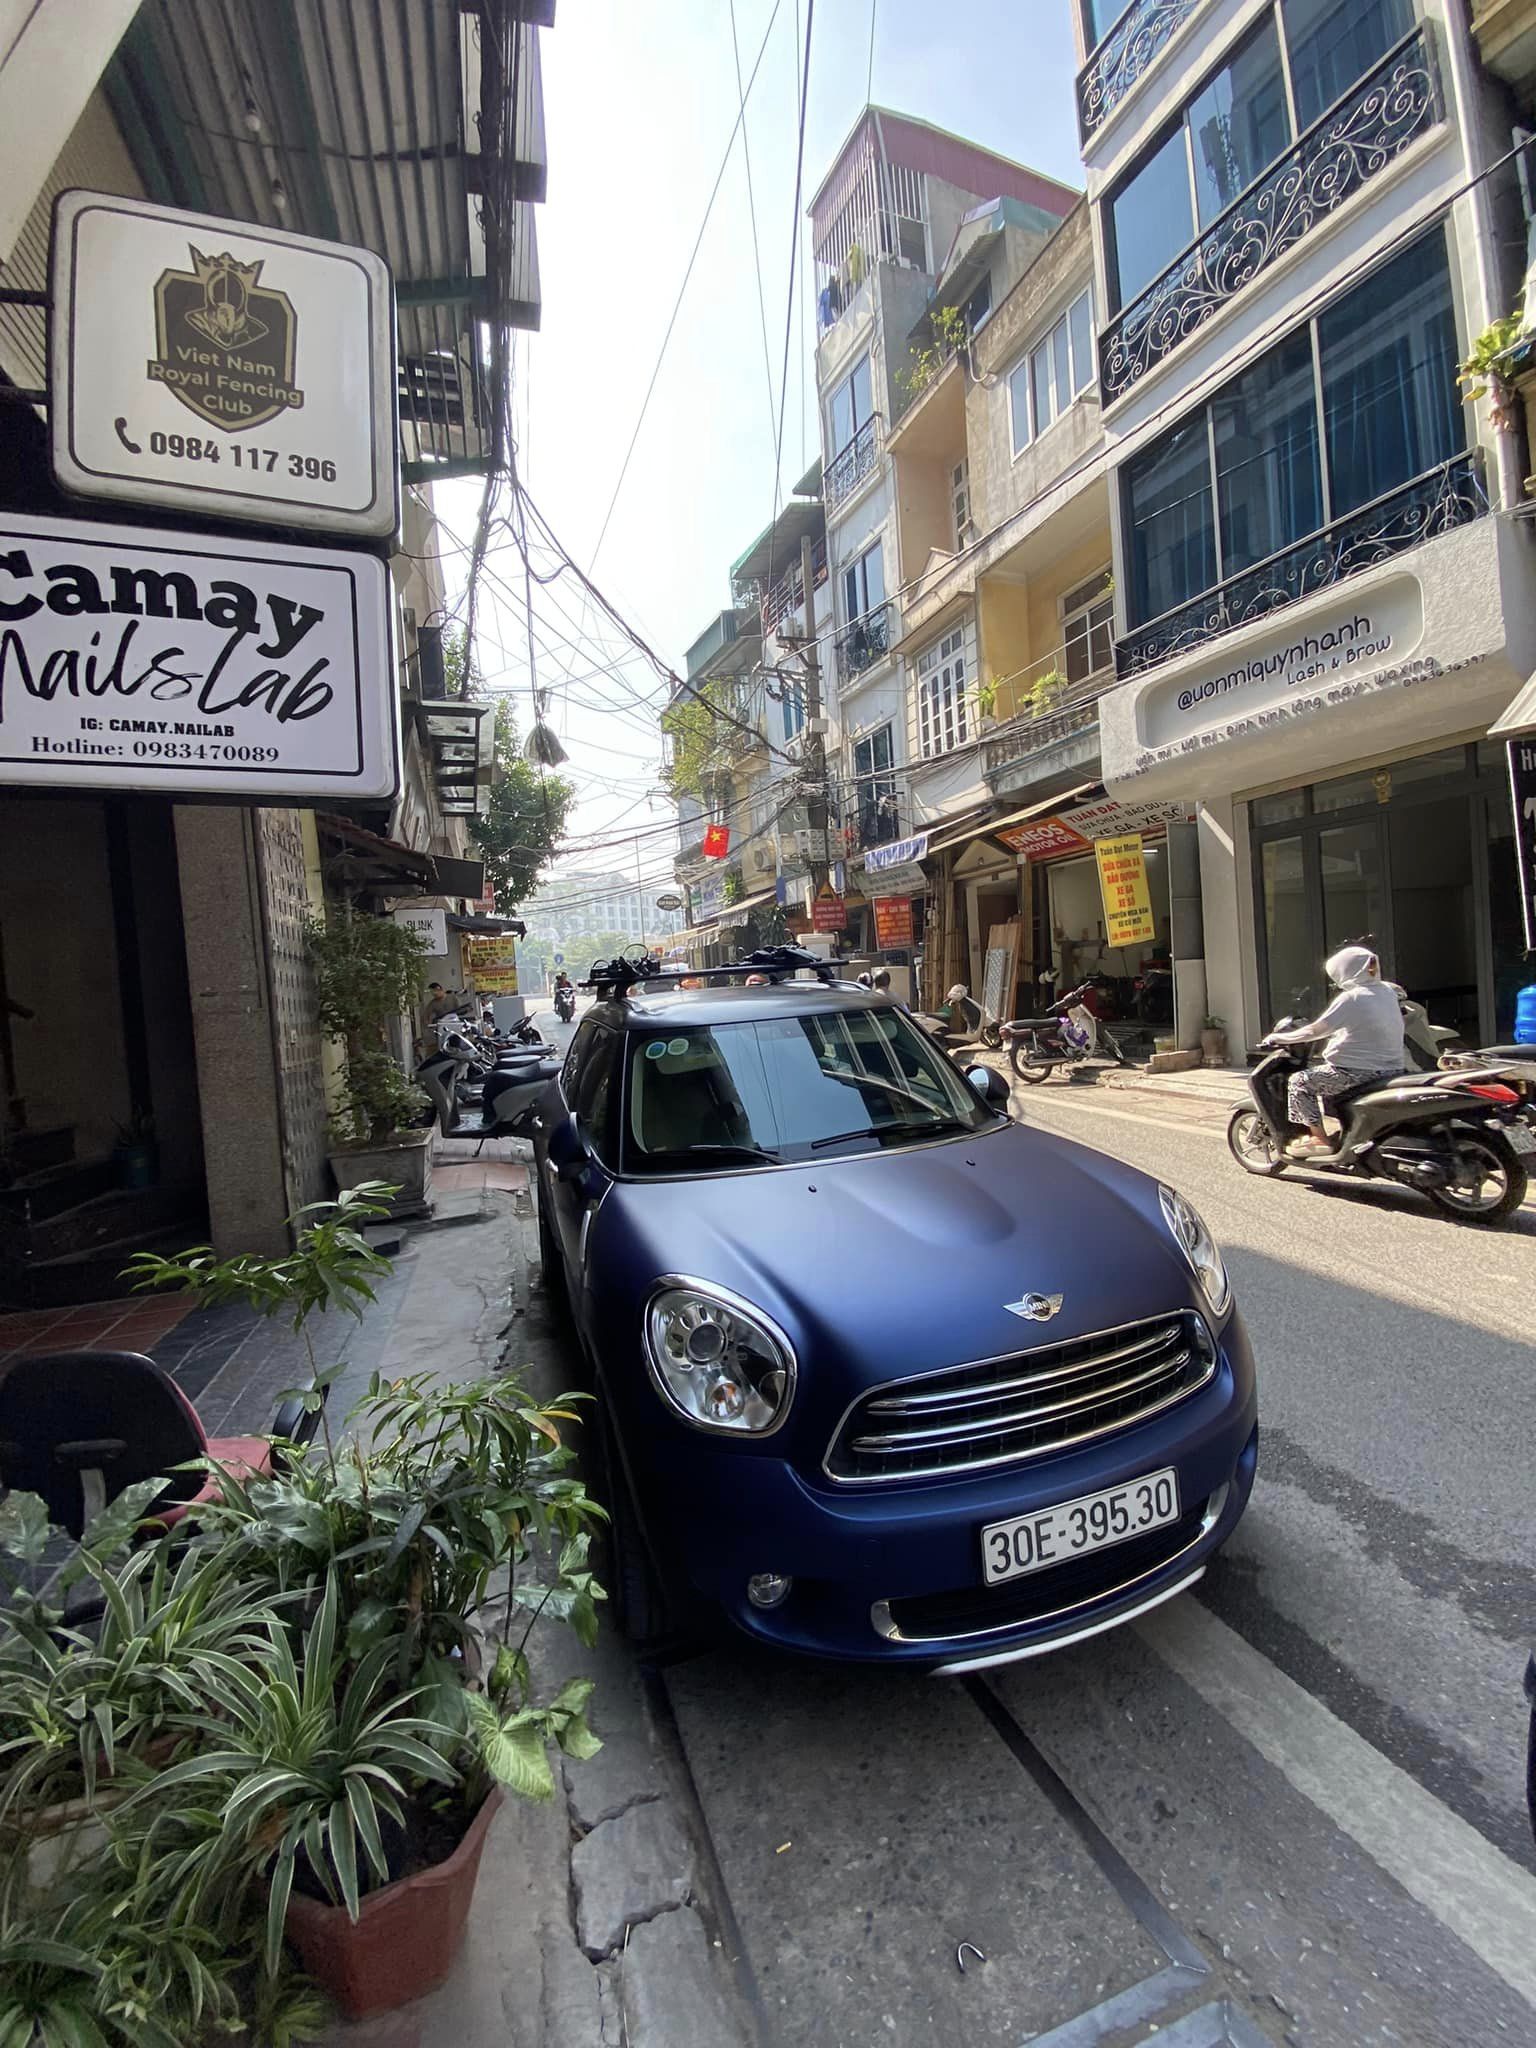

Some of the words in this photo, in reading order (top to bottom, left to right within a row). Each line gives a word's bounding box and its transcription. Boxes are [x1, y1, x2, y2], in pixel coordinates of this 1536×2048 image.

[177, 345, 220, 367] Viet
[227, 353, 276, 377] Nam
[149, 363, 210, 388] Royal
[216, 375, 302, 406] Fencing
[203, 394, 252, 416] Club
[150, 431, 220, 464] 0984
[230, 444, 279, 473] 117
[288, 454, 337, 483] 396
[1177, 615, 1371, 711] @uonmiquynhanh
[1287, 660, 1327, 686] Lash
[1331, 657, 1340, 669] &
[1346, 635, 1392, 664] Brow
[1374, 656, 1436, 686] Waxing
[80, 717, 103, 732] IG:
[109, 718, 235, 738] CAMAY.NAILAB
[31, 736, 124, 757] Hotline:
[133, 740, 280, 763] 0983470089
[1006, 823, 1066, 848] ENEOS
[1056, 834, 1077, 846] OIL
[1115, 820, 1137, 833] GA
[989, 1477, 1172, 1575] 30E-395.30
